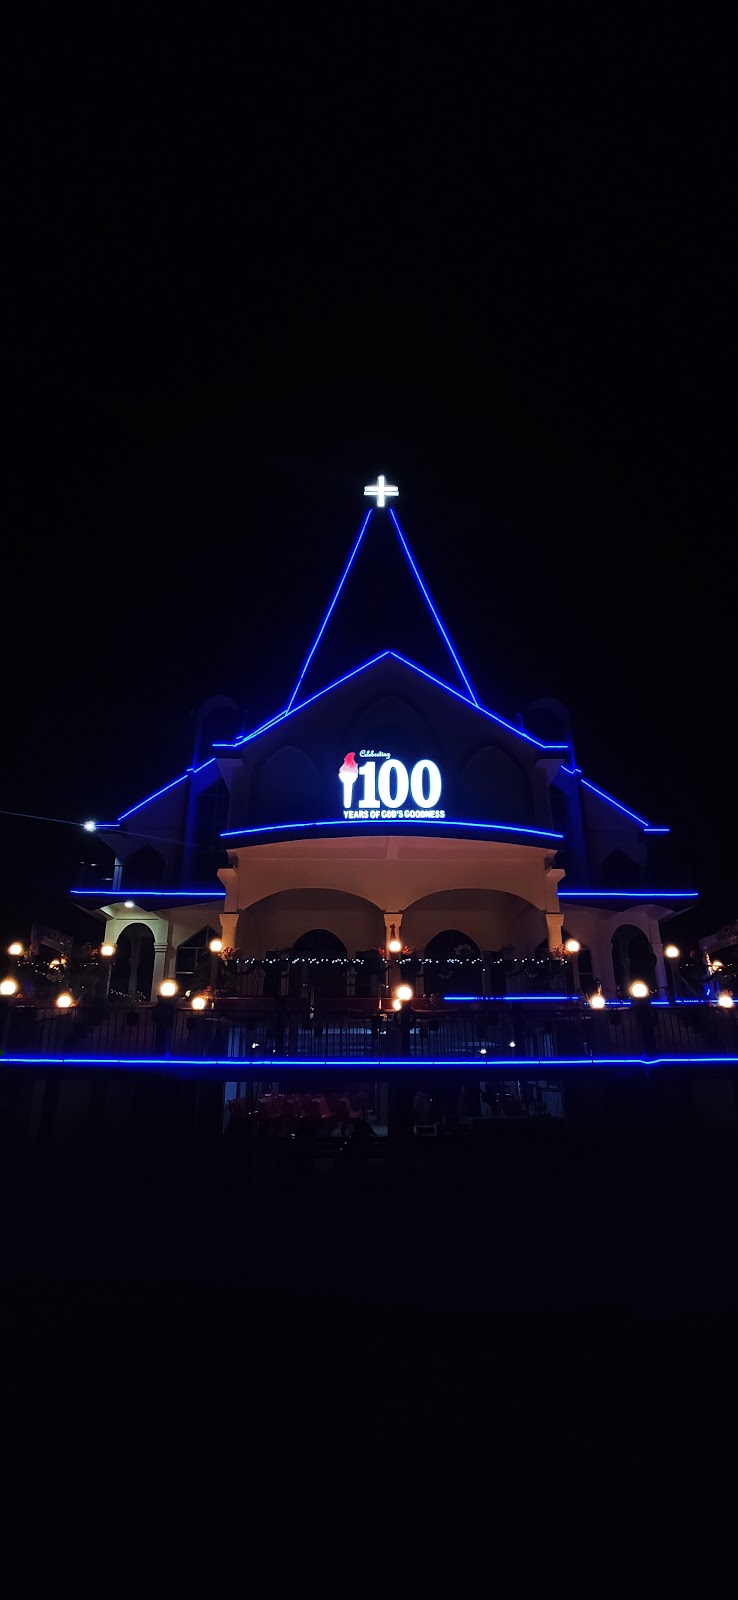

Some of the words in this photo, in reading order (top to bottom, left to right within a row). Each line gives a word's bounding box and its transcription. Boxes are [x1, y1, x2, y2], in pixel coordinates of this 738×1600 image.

[358, 759, 442, 808] 100
[343, 810, 369, 819] YEARS
[370, 810, 380, 819] OF
[381, 810, 403, 819] GOD'S
[404, 810, 446, 819] GOODNESS
